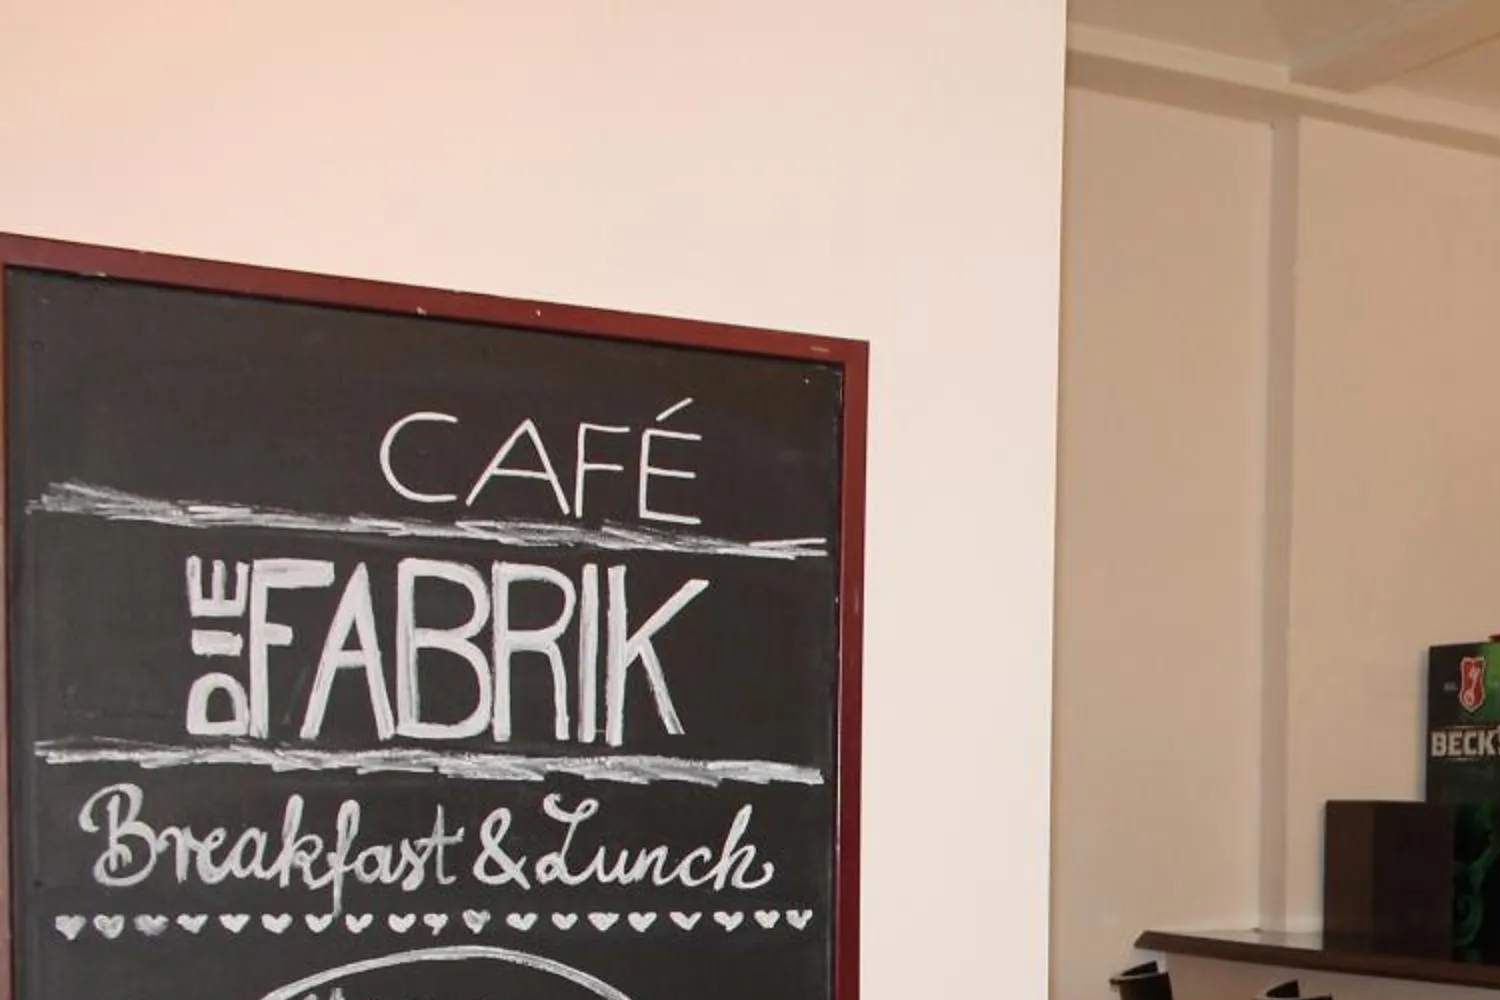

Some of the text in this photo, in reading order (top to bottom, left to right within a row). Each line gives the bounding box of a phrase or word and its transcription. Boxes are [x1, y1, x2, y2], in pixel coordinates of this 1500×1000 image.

[379, 397, 702, 525] CAFÉ
[186, 555, 710, 747] DIE FABRIK
[80, 783, 465, 916] Breakfast
[535, 793, 775, 892] Lunch
